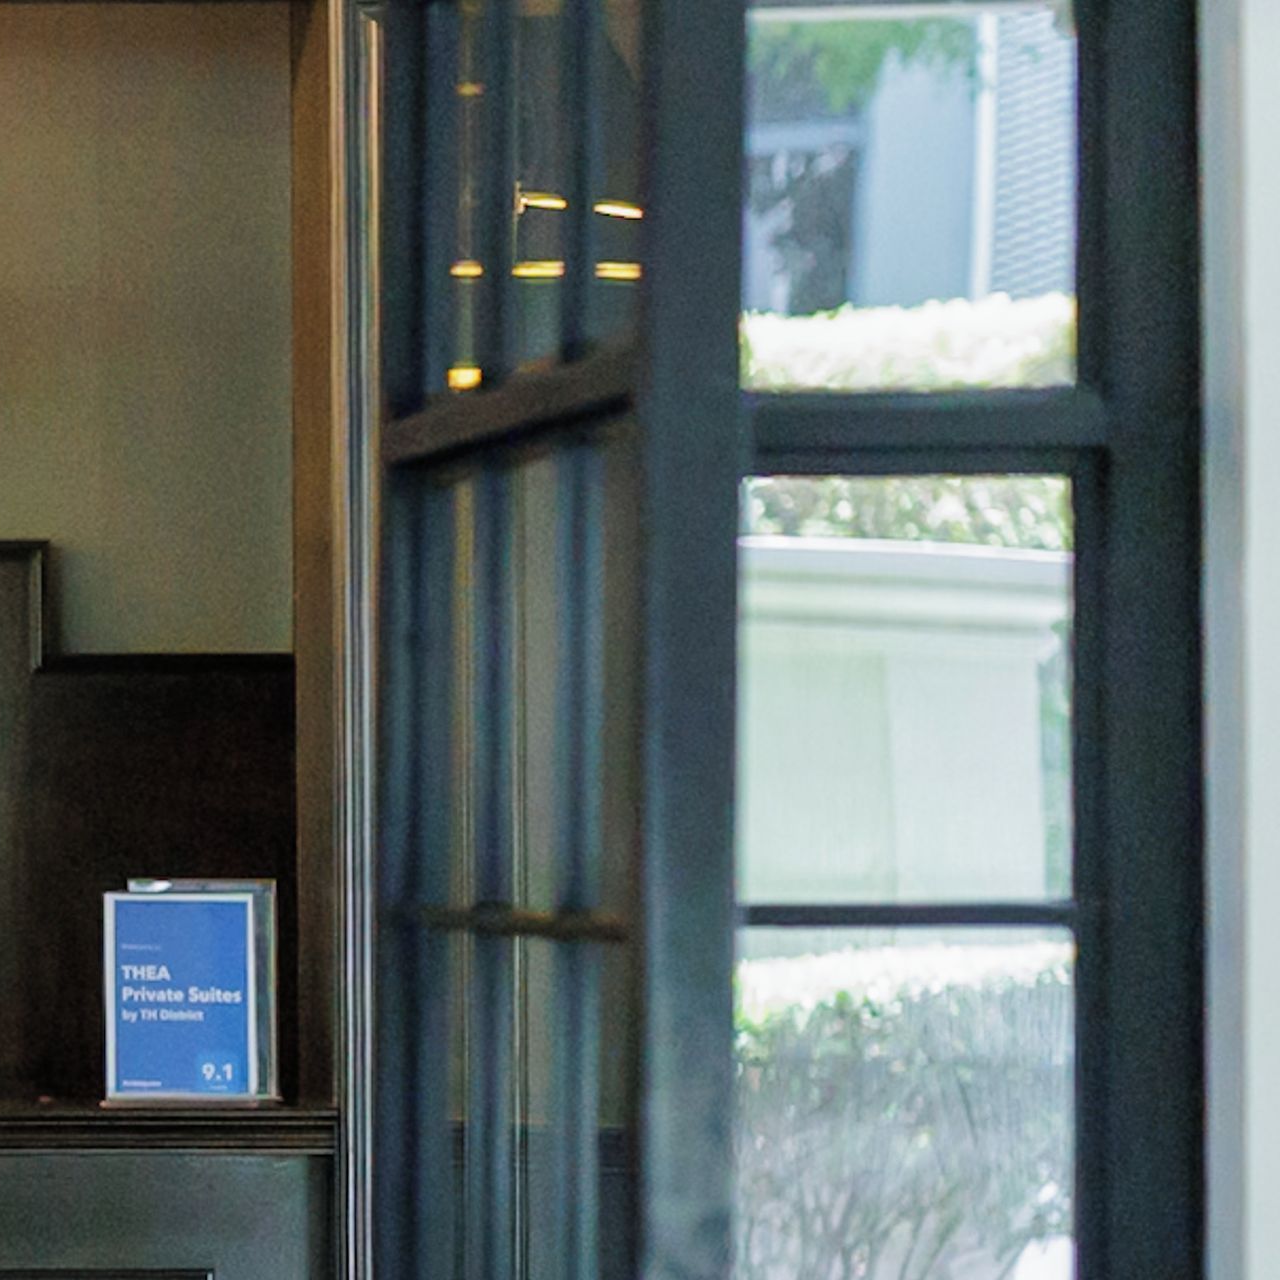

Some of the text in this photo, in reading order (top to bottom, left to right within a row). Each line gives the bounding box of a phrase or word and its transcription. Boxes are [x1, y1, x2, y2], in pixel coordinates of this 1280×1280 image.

[121, 964, 171, 981] THEA
[122, 985, 242, 1003] Private Suites
[121, 1008, 138, 1023] by
[201, 1062, 233, 1081] 9.1
